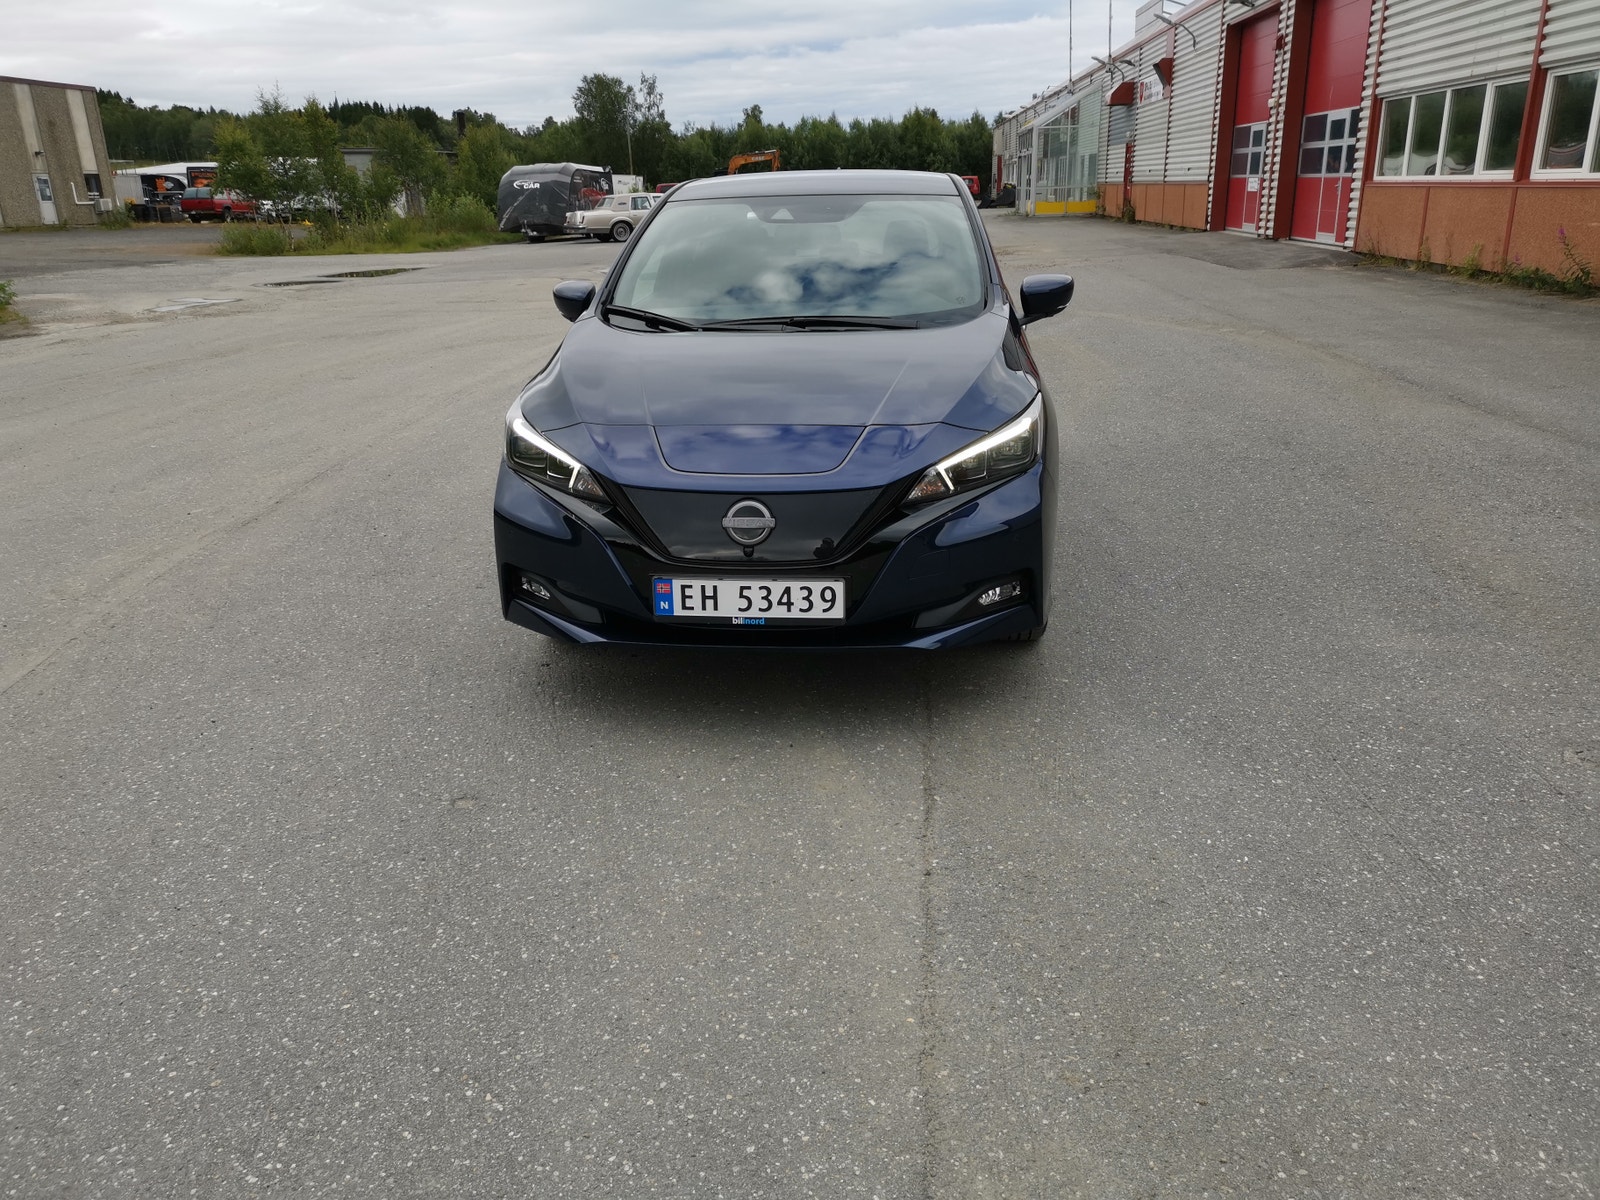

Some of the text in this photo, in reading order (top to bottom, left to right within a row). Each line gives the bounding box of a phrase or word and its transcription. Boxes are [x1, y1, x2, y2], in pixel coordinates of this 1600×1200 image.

[660, 601, 669, 610] N
[680, 584, 837, 613] EH 53439
